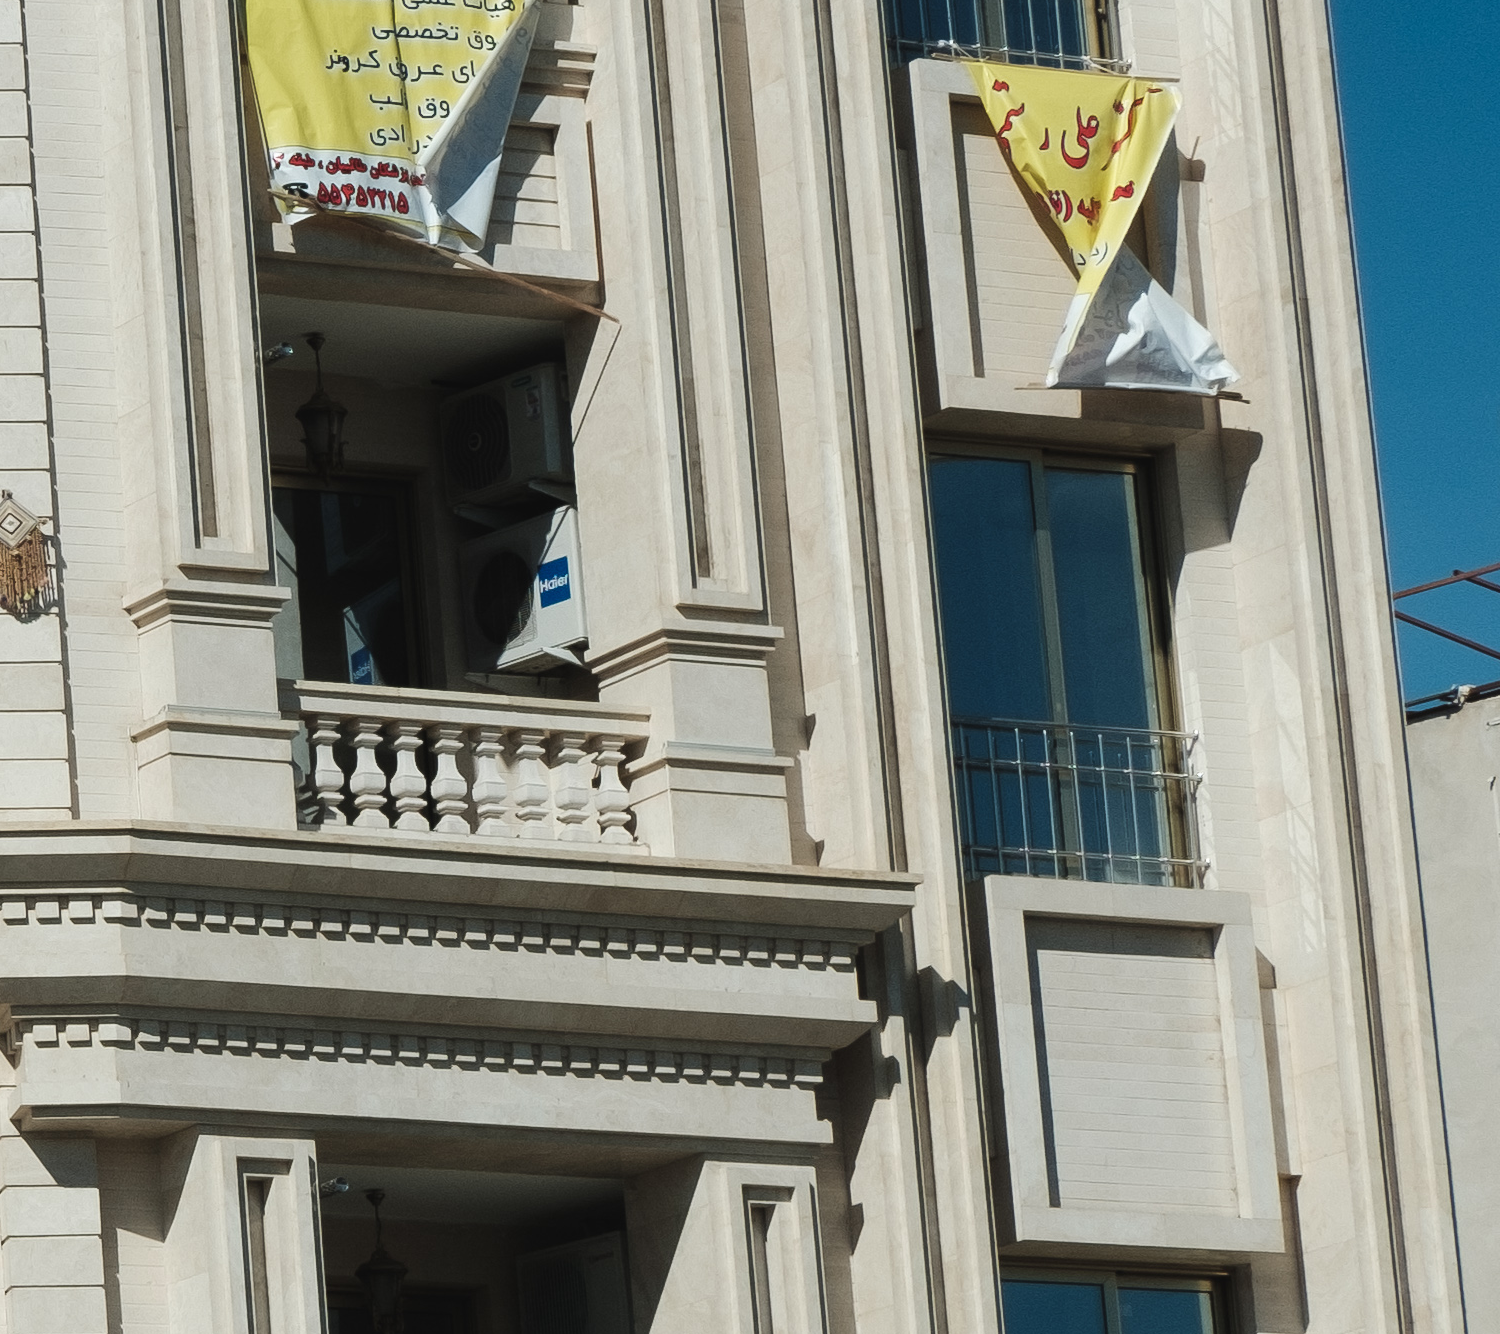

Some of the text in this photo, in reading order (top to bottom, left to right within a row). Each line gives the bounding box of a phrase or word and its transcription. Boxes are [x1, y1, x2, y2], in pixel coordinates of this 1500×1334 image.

[371, 22, 498, 51] وق تخصصی
[325, 49, 381, 73] کرونر
[369, 88, 409, 111] لب
[1060, 105, 1100, 170] علی
[539, 573, 569, 594] Haier
